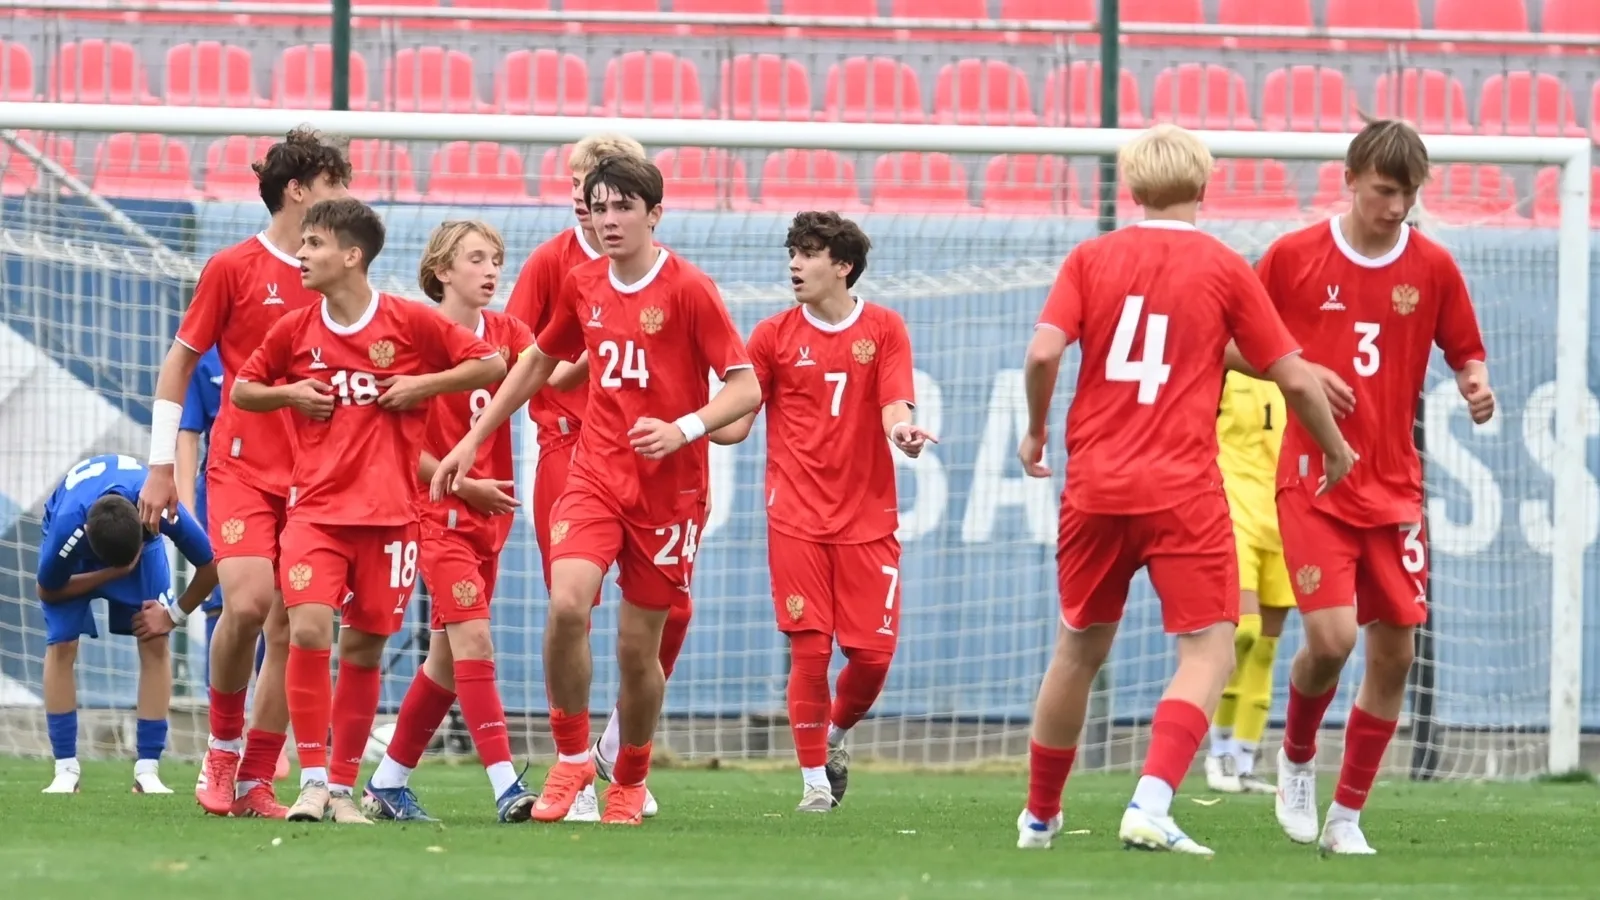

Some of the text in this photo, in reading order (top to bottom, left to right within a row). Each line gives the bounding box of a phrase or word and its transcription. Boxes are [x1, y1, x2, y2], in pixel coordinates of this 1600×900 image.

[598, 340, 649, 388] 24
[1105, 295, 1171, 404] 4
[1353, 321, 1380, 377] 3
[331, 370, 379, 405] 18
[824, 372, 847, 416] 7
[1262, 402, 1273, 430] 1
[384, 541, 417, 588] 18
[653, 519, 698, 565] 24
[1399, 522, 1425, 573] 3
[881, 565, 898, 609] 7
